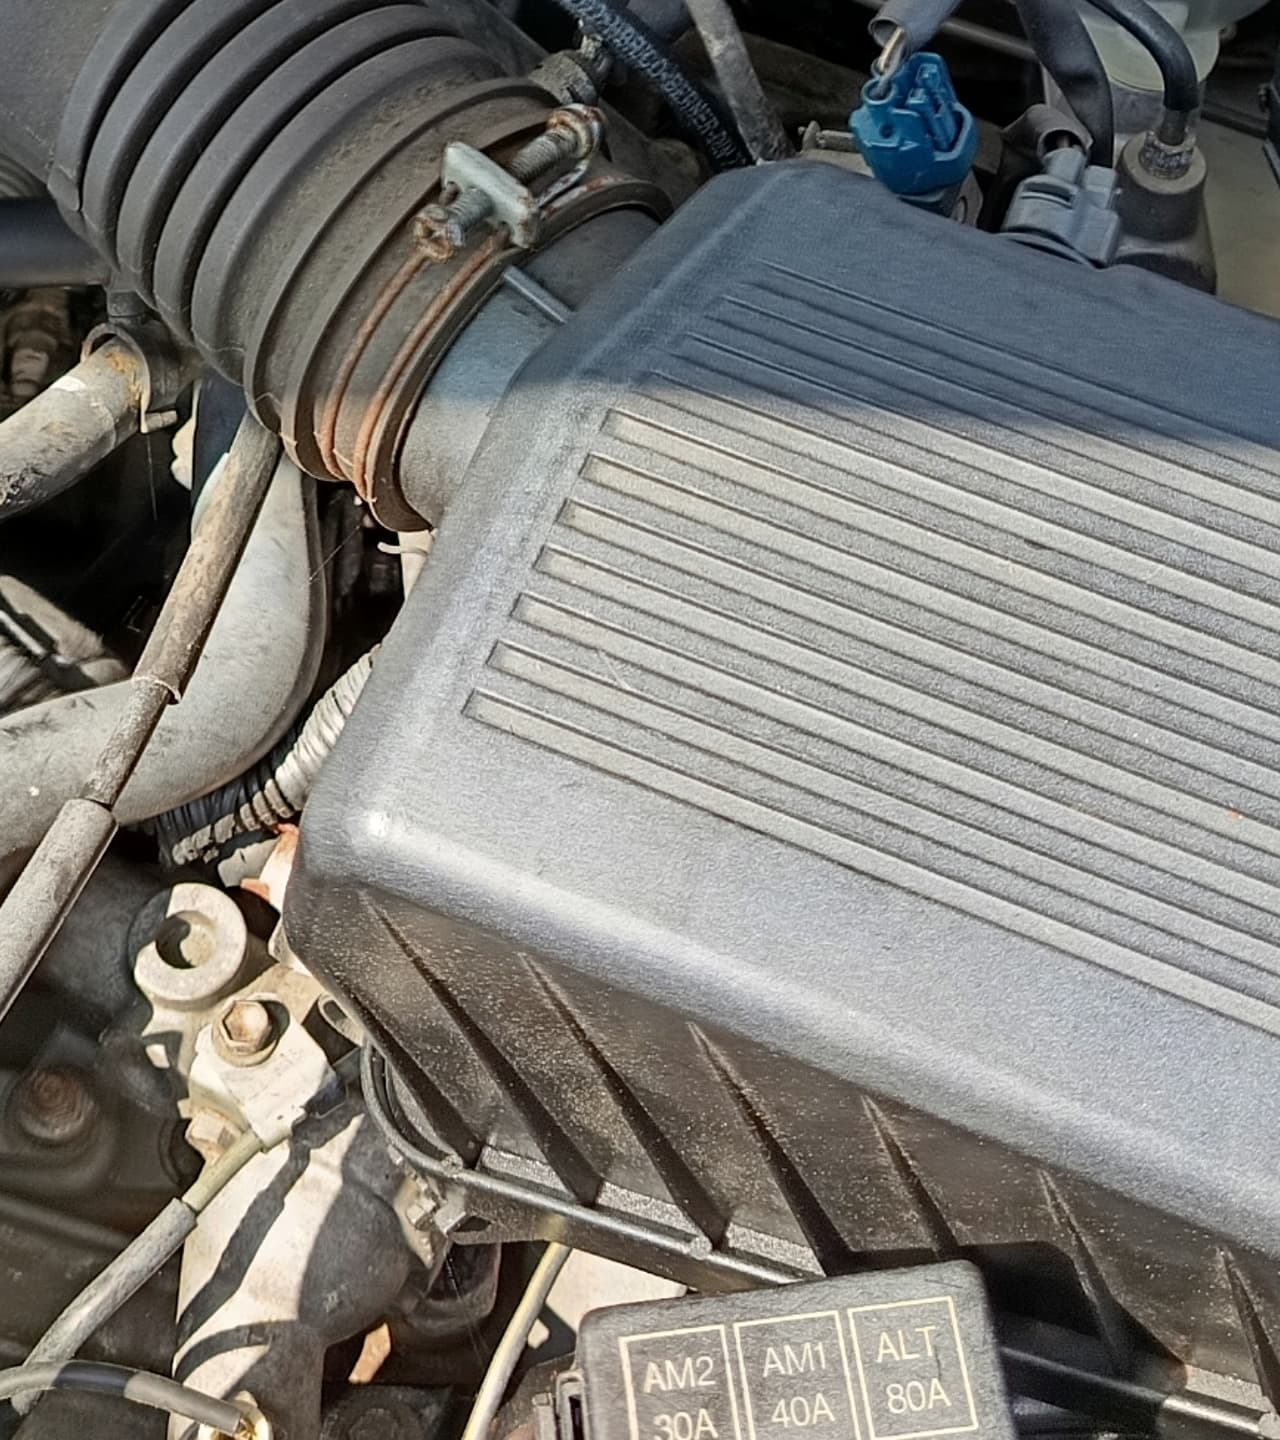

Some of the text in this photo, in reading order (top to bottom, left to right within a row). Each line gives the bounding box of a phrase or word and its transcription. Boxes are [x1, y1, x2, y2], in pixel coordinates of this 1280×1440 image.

[762, 1342, 828, 1378] AM1
[876, 1325, 937, 1362] ALT
[643, 1356, 716, 1393] AM2
[771, 1393, 835, 1429] 40A
[885, 1380, 952, 1415] 80A
[653, 1408, 719, 1440] 30A
